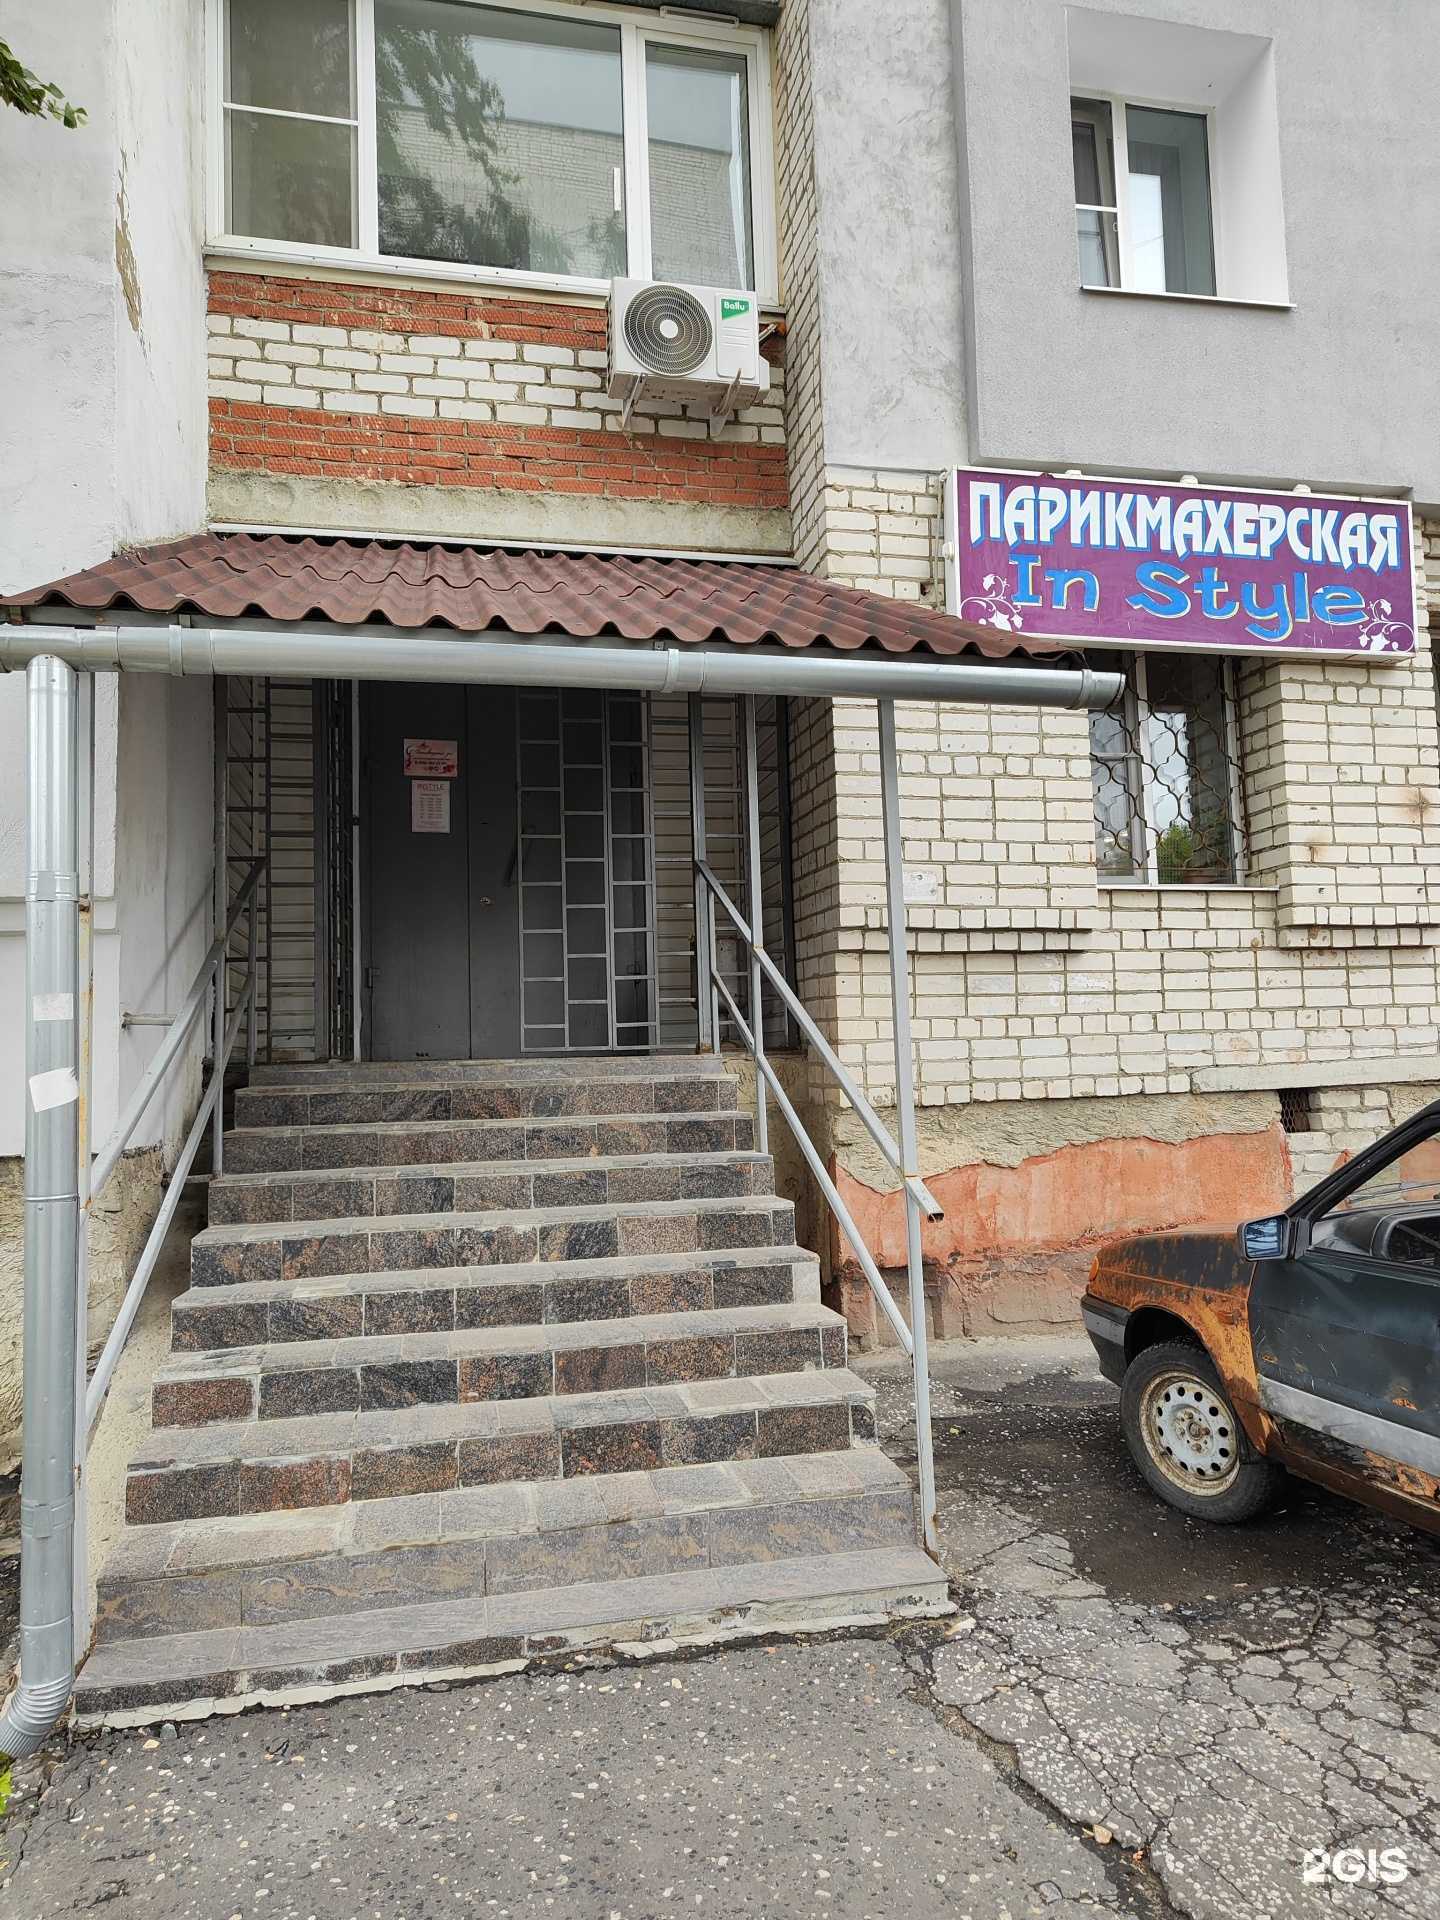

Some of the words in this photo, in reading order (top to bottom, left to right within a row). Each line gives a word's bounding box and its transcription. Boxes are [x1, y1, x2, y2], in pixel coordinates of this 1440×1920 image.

[724, 301, 745, 311] Ballu
[969, 480, 1398, 573] ПАРИКМАХЕРСКАЯ
[1009, 553, 1100, 611] In
[1125, 560, 1370, 641] Style
